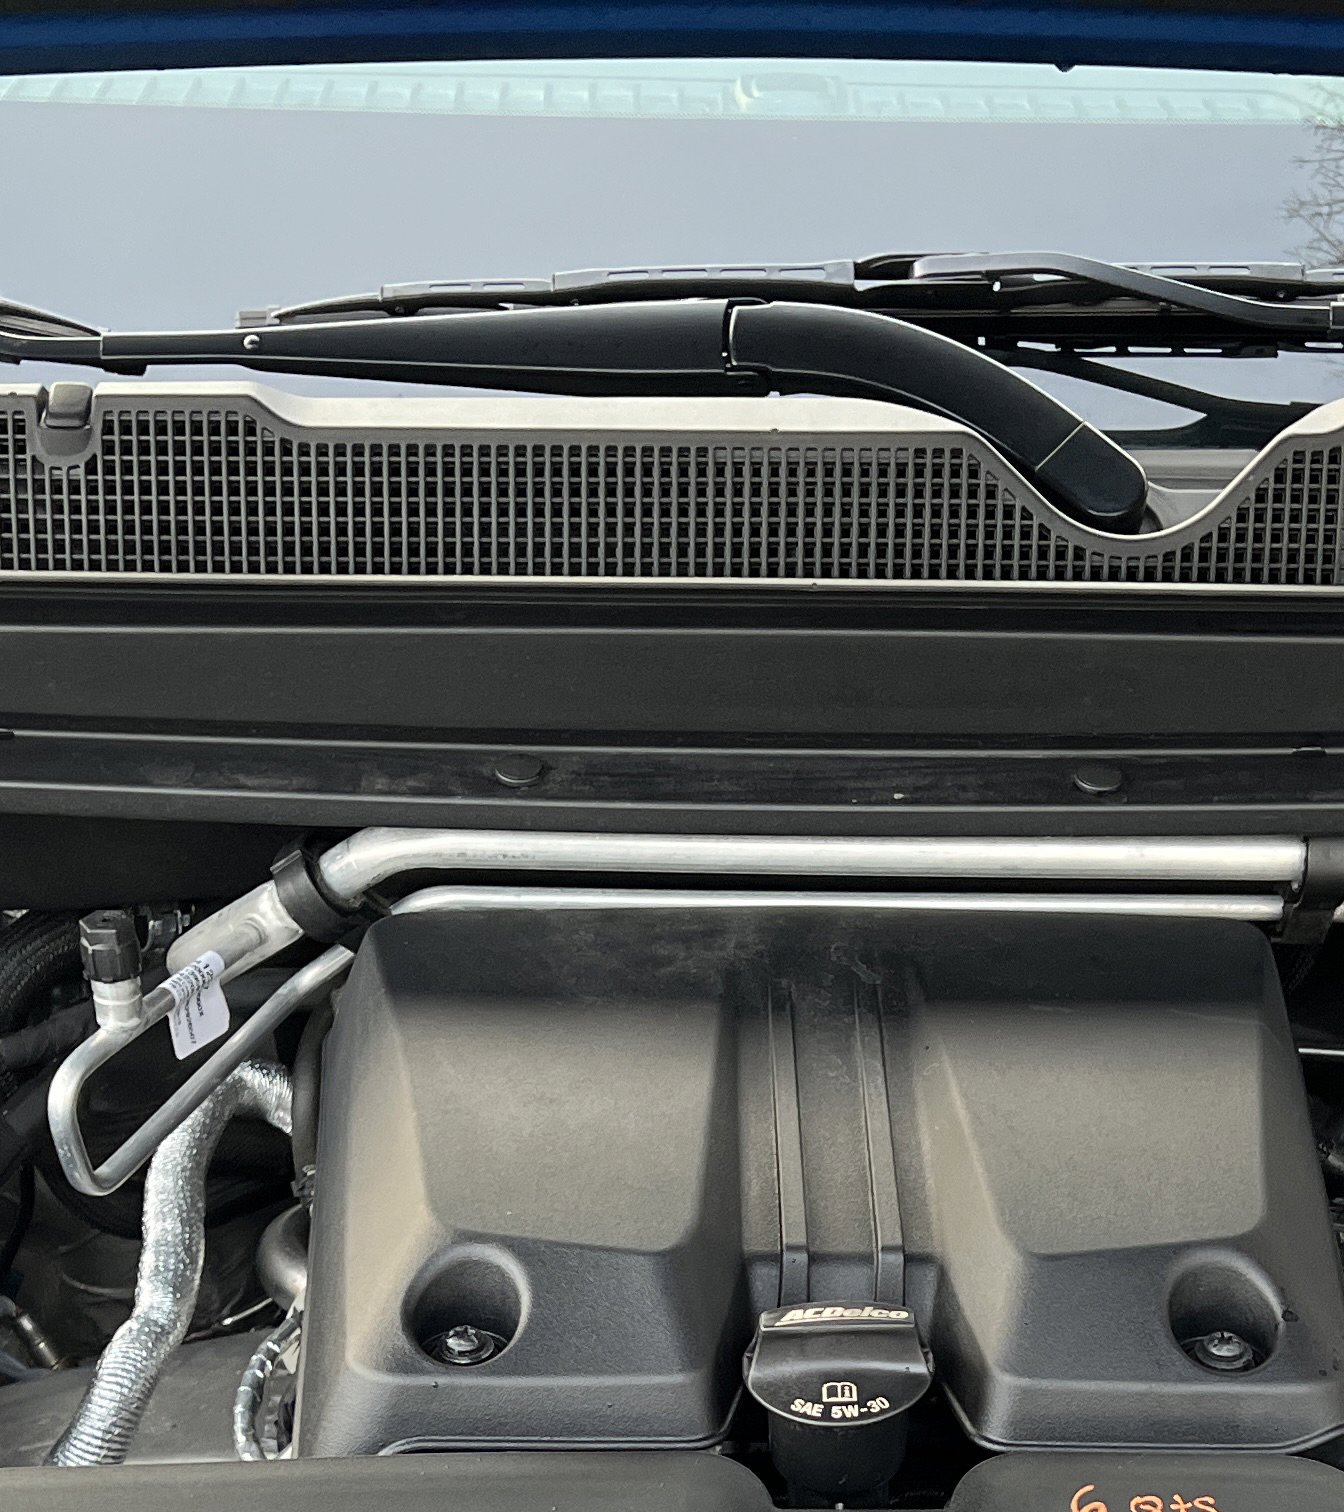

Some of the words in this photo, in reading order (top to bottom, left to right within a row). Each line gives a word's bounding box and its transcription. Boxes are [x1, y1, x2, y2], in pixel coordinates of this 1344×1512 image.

[778, 1305, 910, 1324] ACDelco
[789, 1398, 825, 1418] SAE
[830, 1396, 890, 1419] 5W-30
